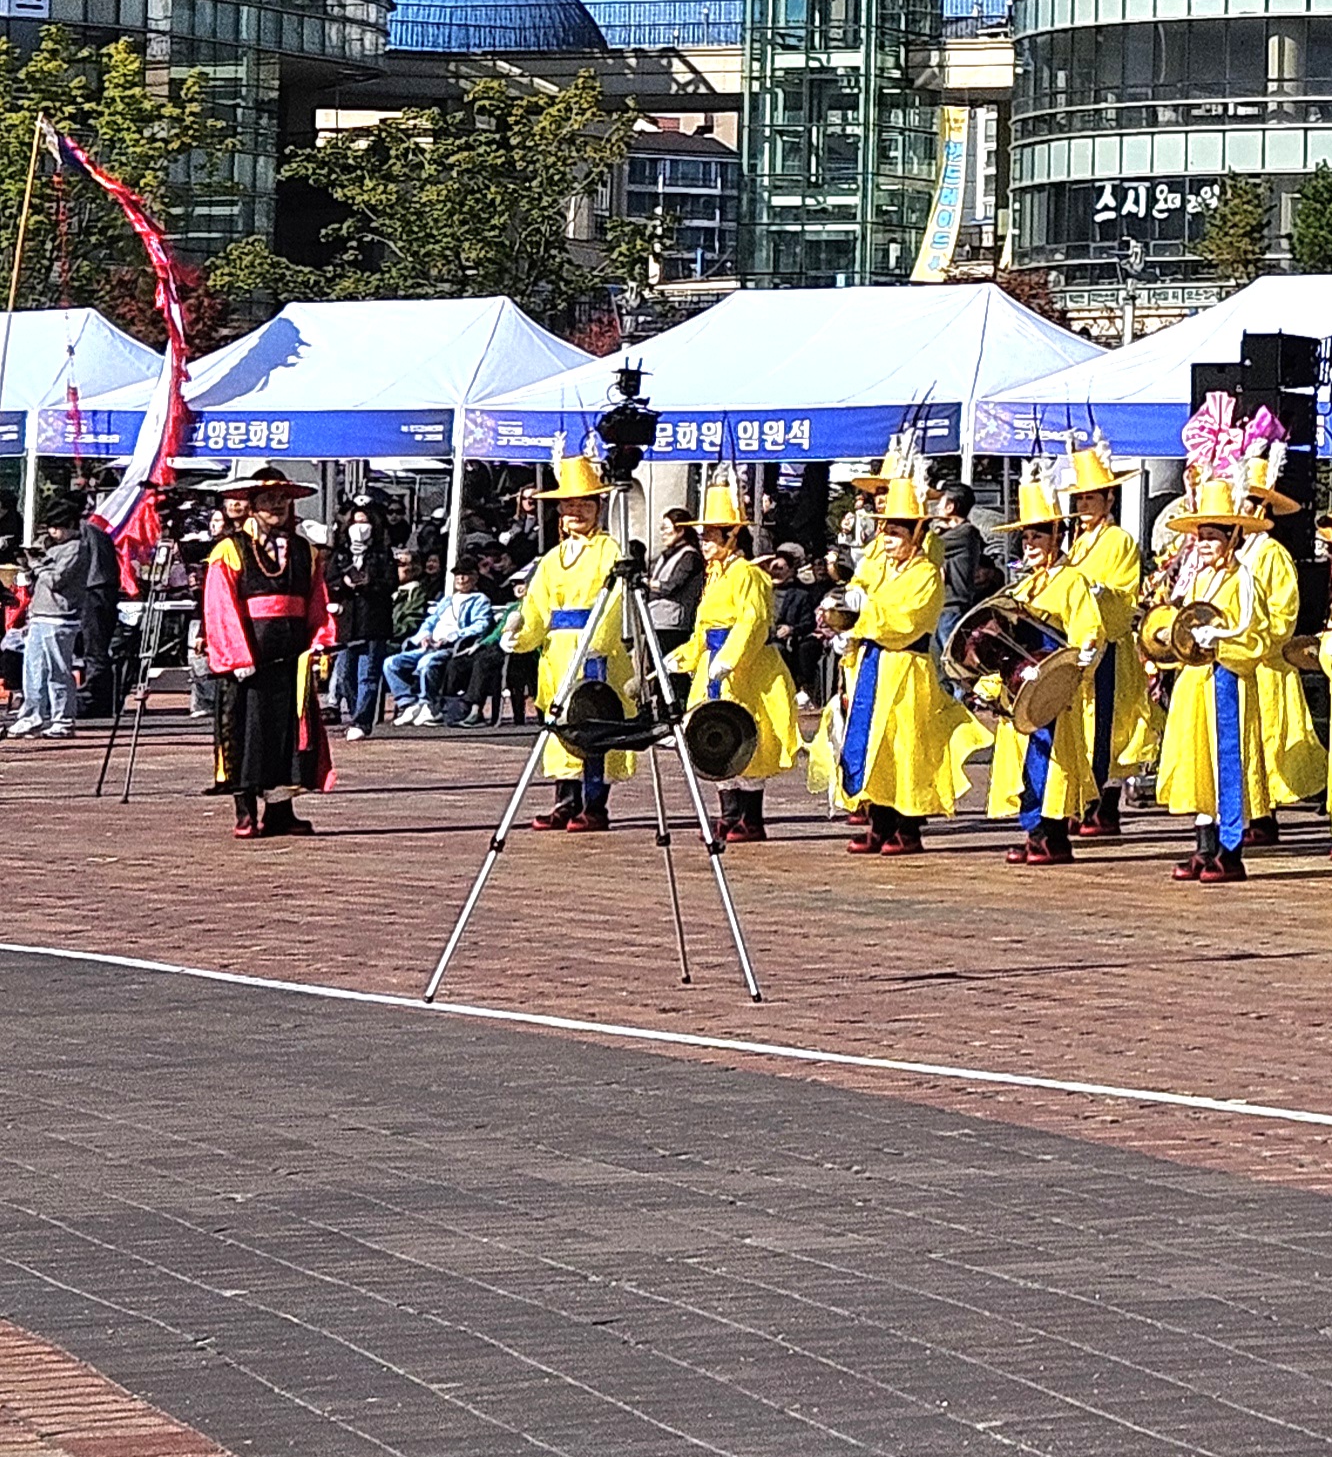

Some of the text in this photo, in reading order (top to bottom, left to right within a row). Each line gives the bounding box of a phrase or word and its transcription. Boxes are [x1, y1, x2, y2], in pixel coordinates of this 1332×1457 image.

[1093, 183, 1146, 223] 스시
[652, 419, 811, 452] 문화원 임원석
